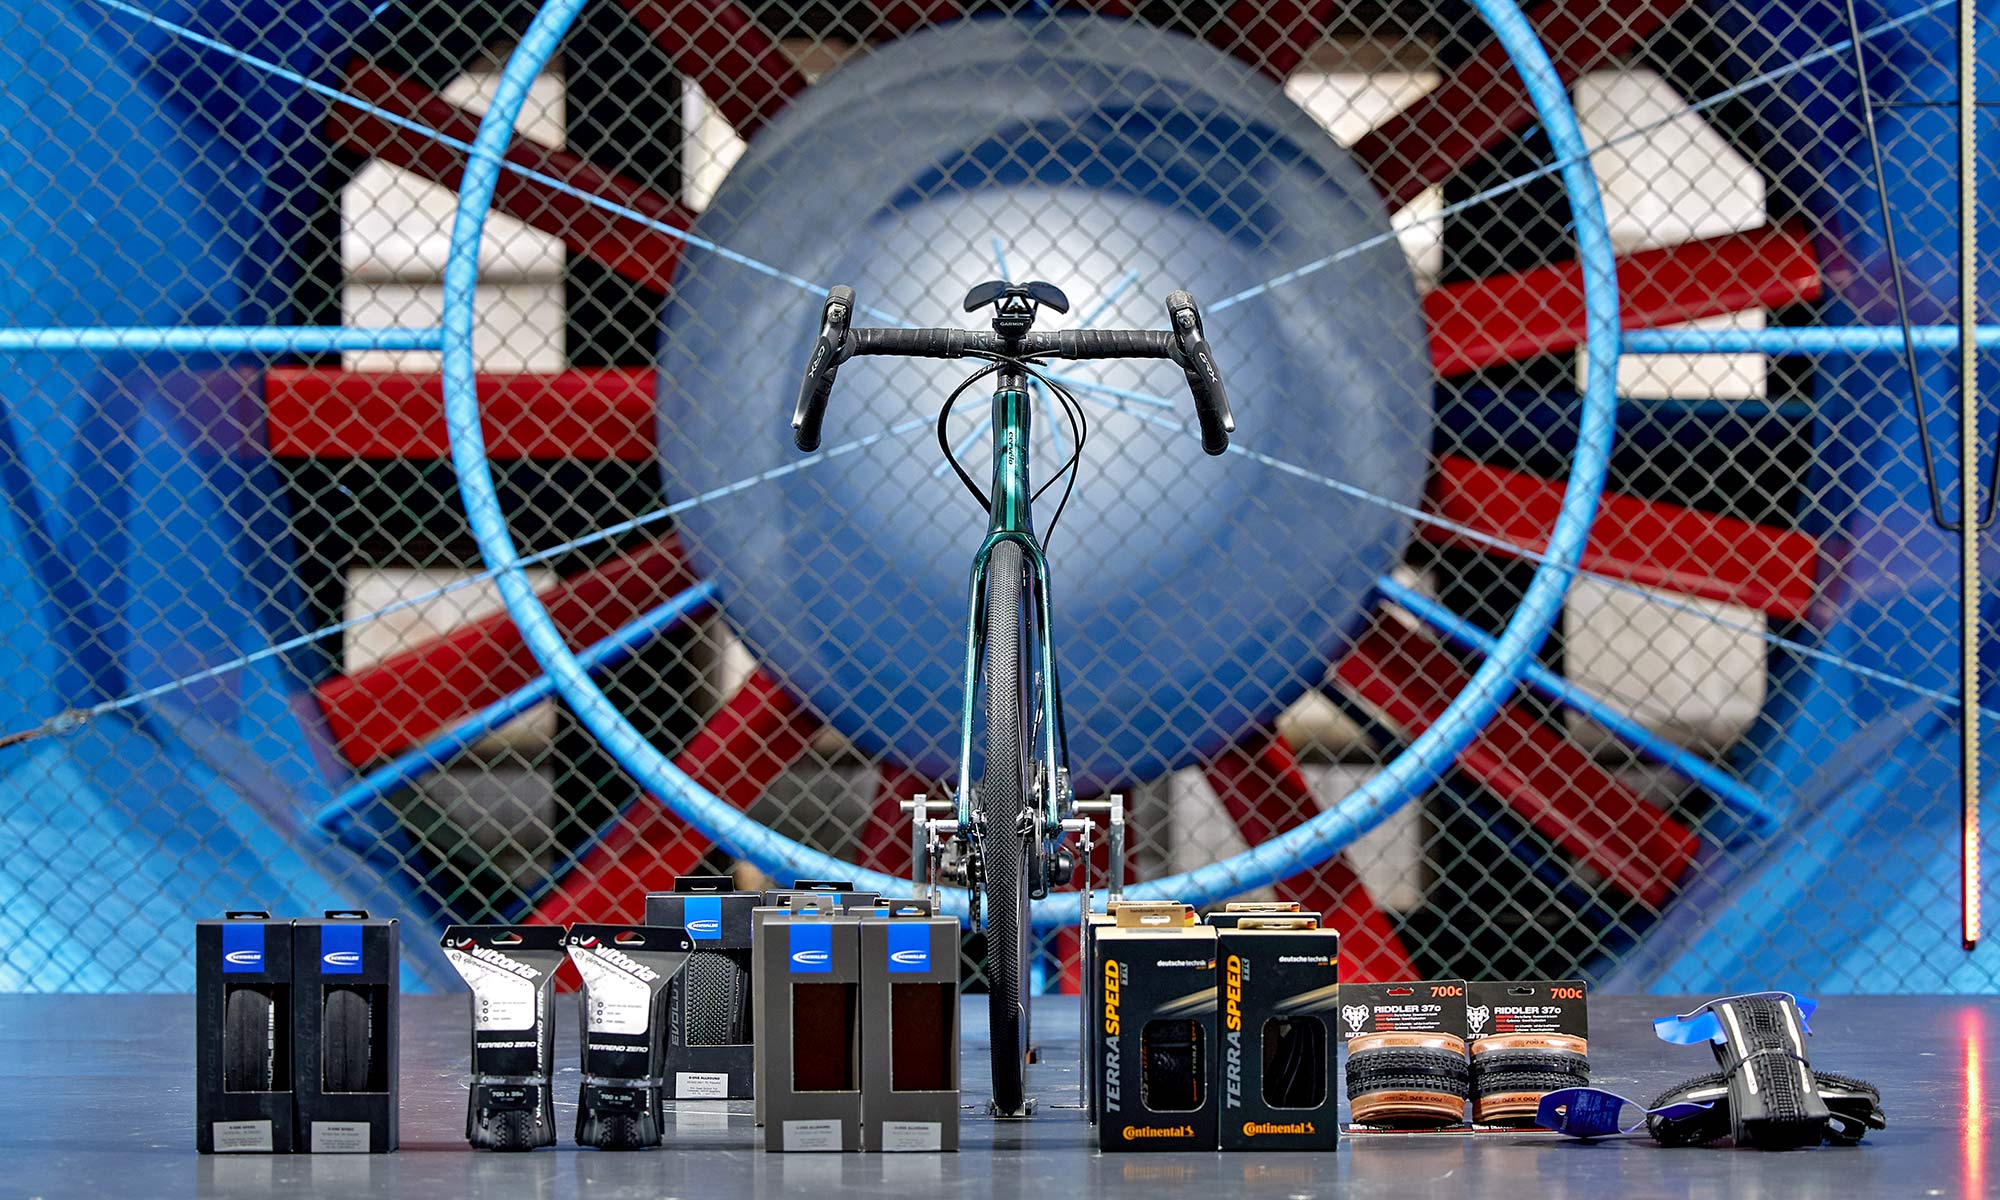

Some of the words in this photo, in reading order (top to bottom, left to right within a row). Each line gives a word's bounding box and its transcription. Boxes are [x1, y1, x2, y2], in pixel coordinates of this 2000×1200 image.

[1199, 352, 1218, 383] GRX
[1430, 986, 1463, 997] 700c
[1550, 988, 1583, 999] 700c
[1374, 1005, 1419, 1013] RIDDLER
[1494, 1007, 1539, 1015] RIDDLER
[589, 1044, 625, 1052] TERRENO
[1122, 1125, 1184, 1141] Continental
[1243, 1122, 1304, 1137] Continental
